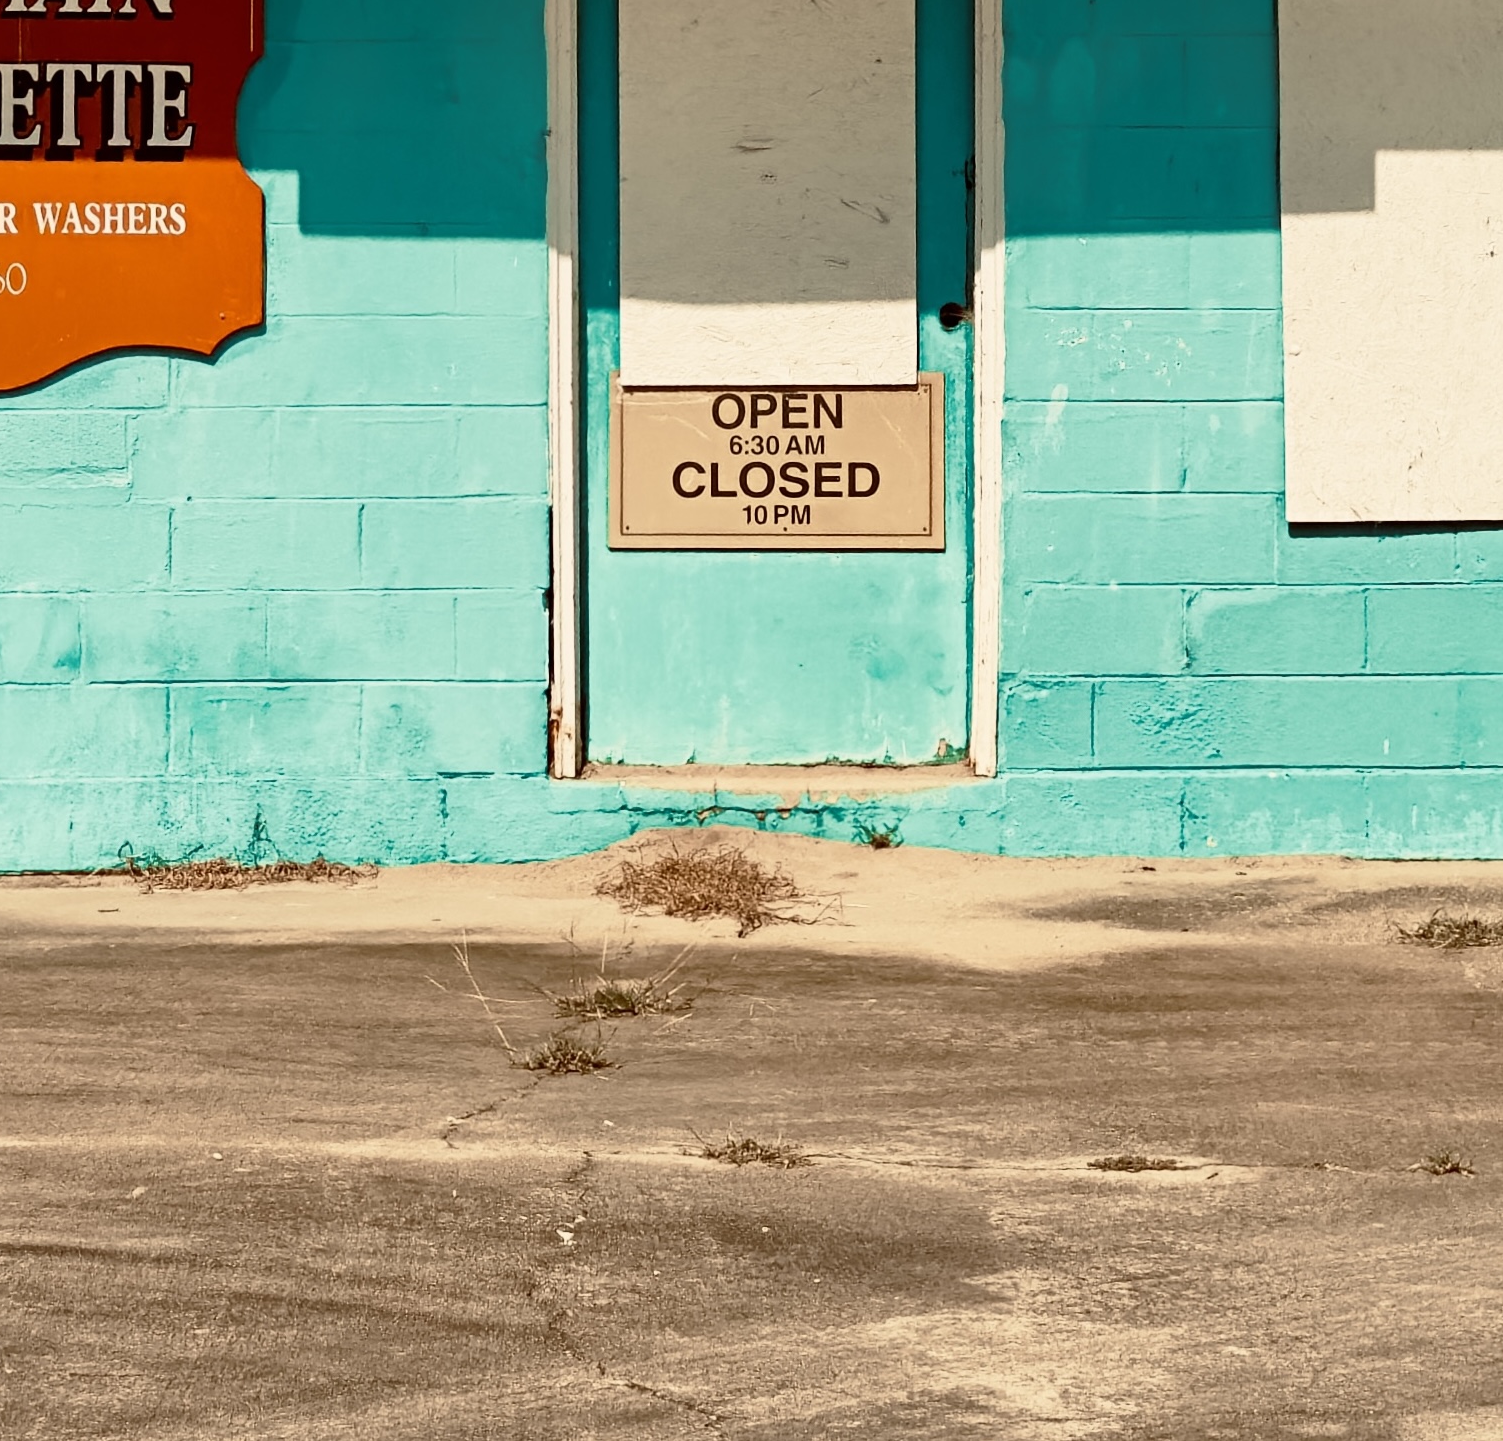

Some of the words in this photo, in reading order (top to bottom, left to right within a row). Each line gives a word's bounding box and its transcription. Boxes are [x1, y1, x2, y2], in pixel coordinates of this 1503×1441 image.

[32, 202, 186, 235] WASHERS
[711, 393, 844, 430] OPEN
[729, 435, 780, 456] 6:30
[785, 435, 825, 455] AM
[672, 461, 881, 499] CLOSED
[742, 504, 768, 525] 10
[774, 504, 811, 525] PM
